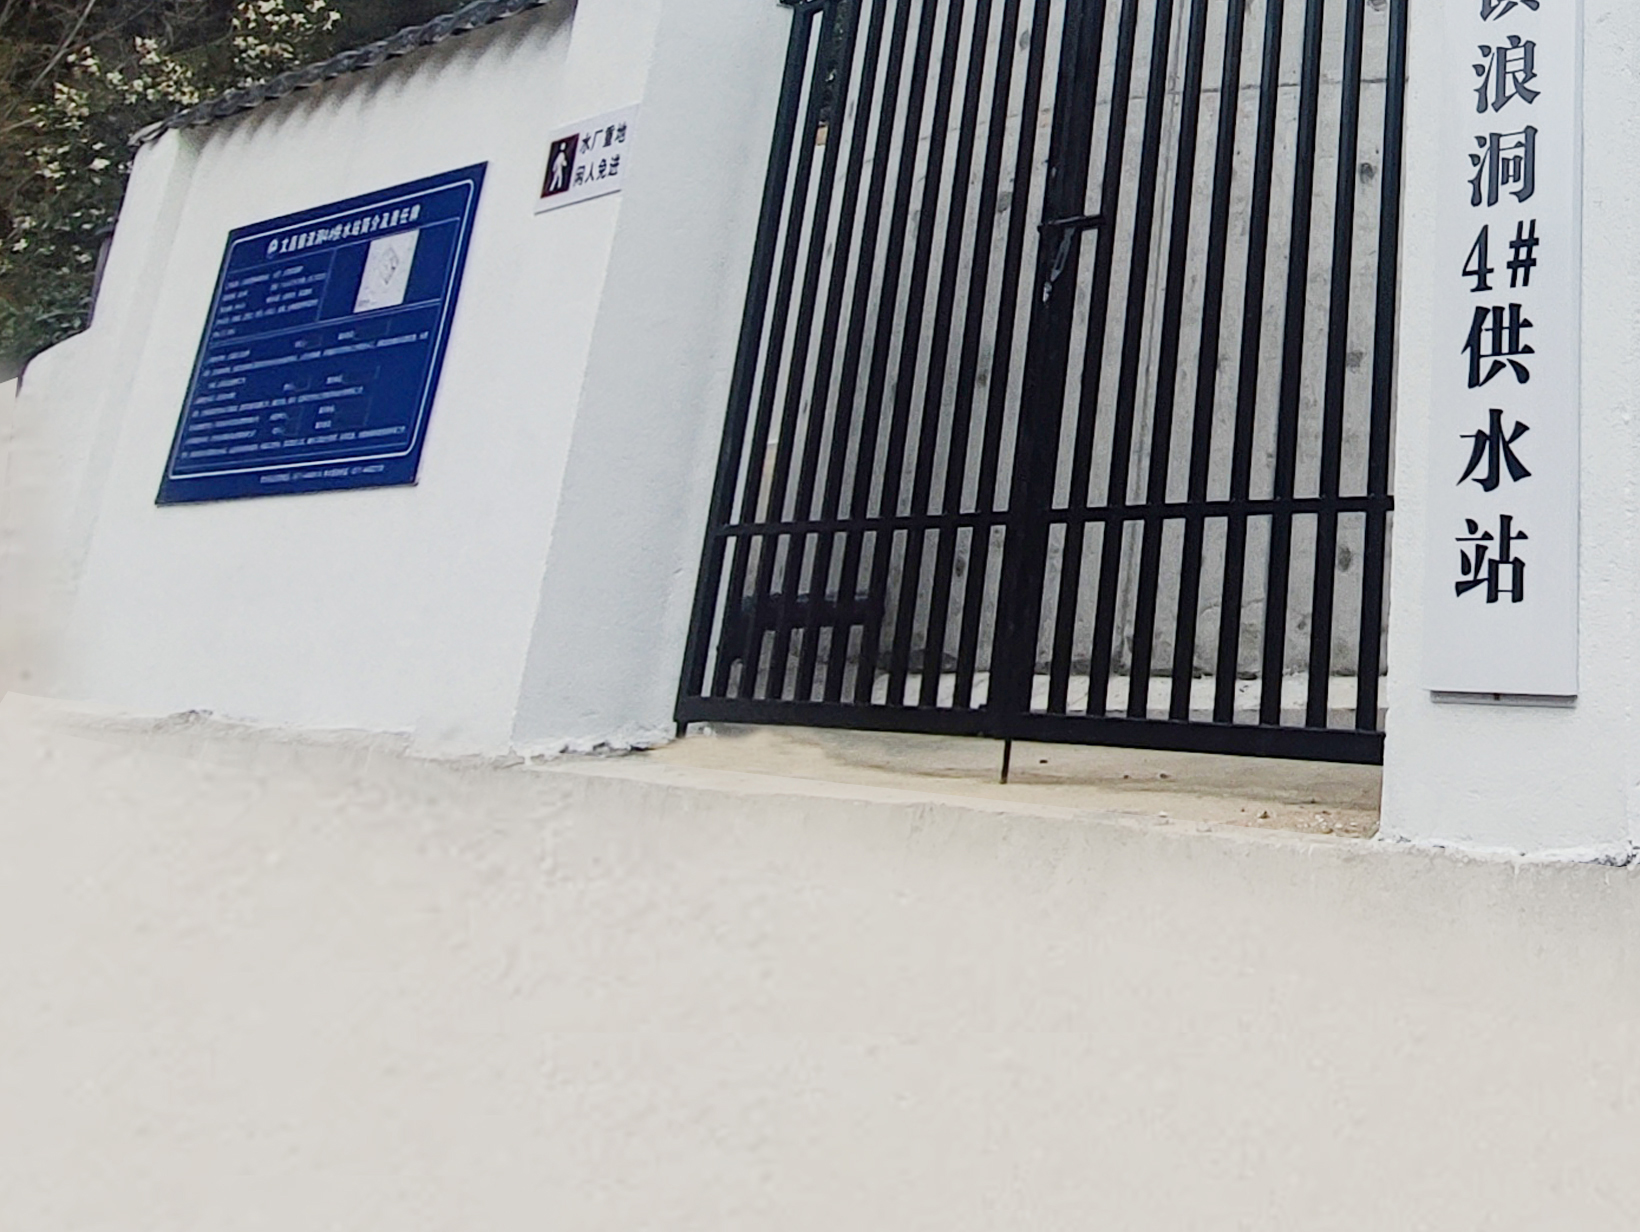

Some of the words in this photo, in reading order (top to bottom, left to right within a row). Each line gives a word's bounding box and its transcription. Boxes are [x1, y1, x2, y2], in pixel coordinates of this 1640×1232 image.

[579, 121, 627, 155] 水厂重地
[573, 154, 620, 187] 闲人免进
